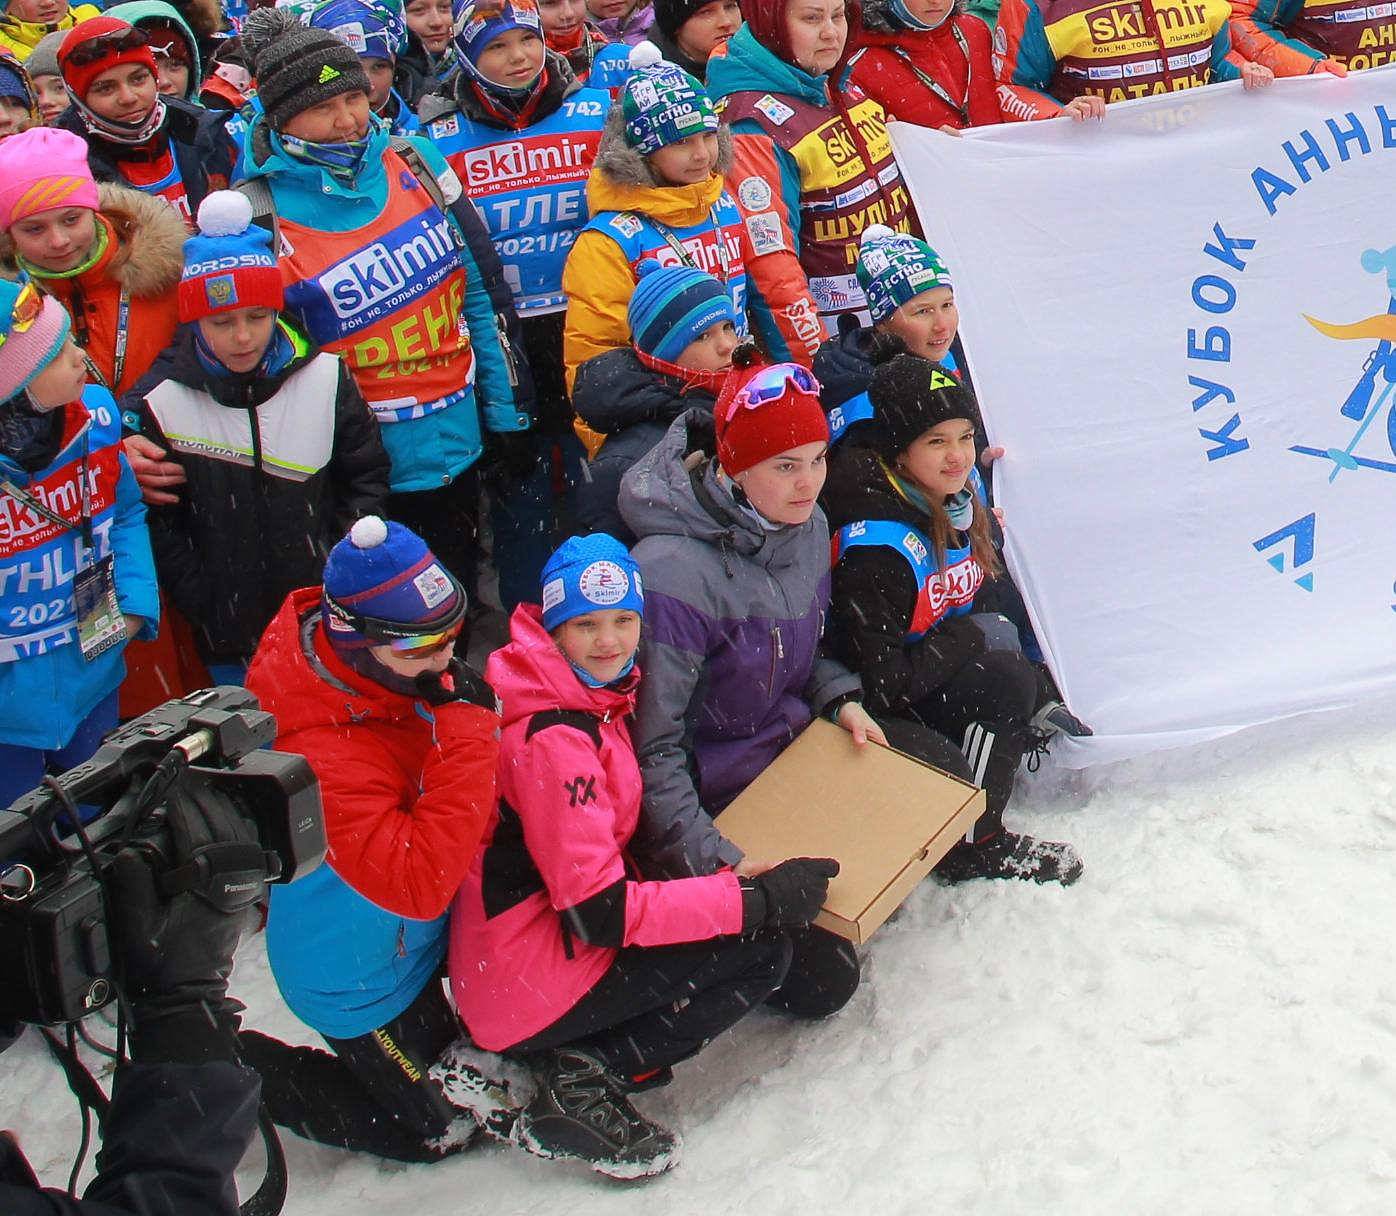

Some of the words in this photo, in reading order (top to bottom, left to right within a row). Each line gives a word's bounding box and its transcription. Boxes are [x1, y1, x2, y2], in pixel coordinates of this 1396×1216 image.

[563, 101, 604, 119] 742
[652, 102, 693, 128] ЕСТНО
[470, 138, 587, 183] skimir
[478, 189, 582, 234] ТЛЕ
[183, 254, 273, 277] NORDSKI
[332, 218, 455, 312] skimir
[885, 262, 924, 290] ЕСТНО
[1187, 221, 1257, 462] КУБОК
[581, 565, 597, 590] КУБОК
